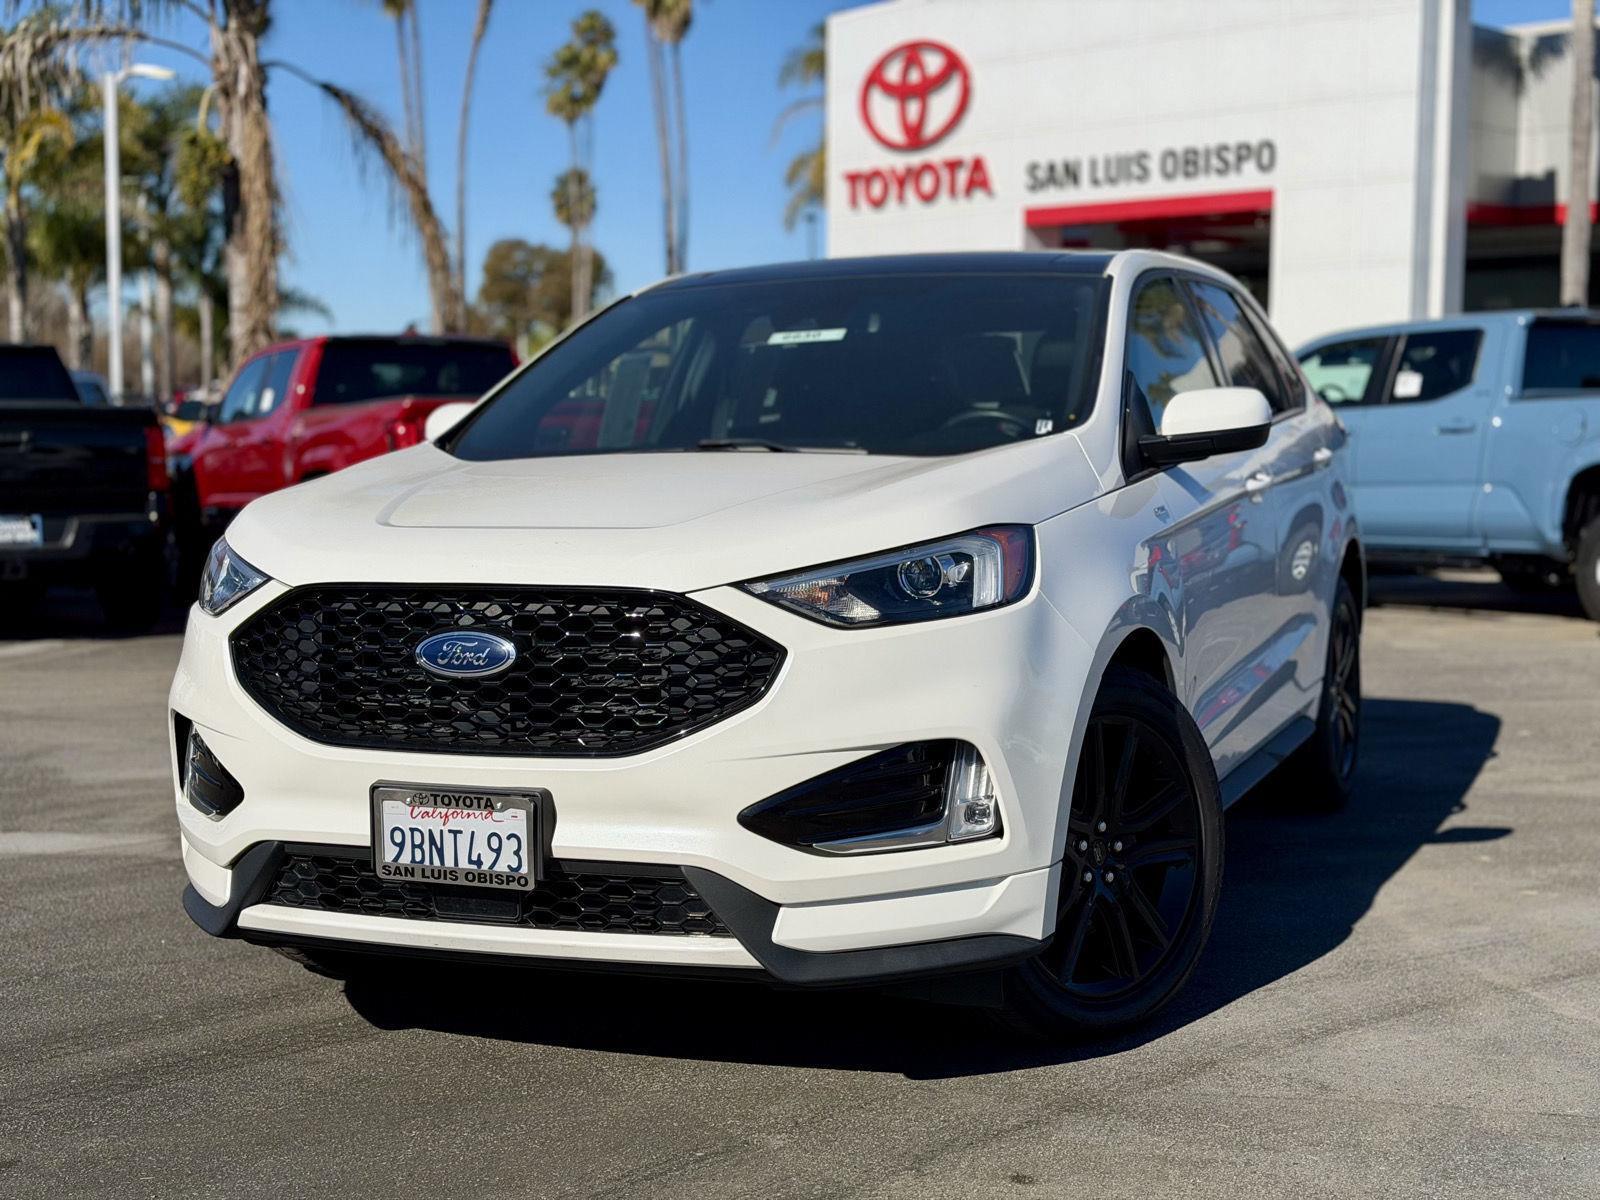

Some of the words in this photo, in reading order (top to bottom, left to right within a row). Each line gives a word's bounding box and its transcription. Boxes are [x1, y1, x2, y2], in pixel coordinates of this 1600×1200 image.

[1026, 159, 1080, 192] SAN
[1089, 152, 1150, 188] LUIS
[1160, 139, 1277, 179] OBISPO
[843, 156, 993, 209] TOYOTA
[437, 640, 491, 665] Ford
[430, 793, 495, 810] TOYOTA
[409, 805, 504, 826] California
[389, 826, 523, 873] 9BNT493
[381, 864, 415, 878] SAN
[421, 868, 459, 882] LUIS
[464, 871, 529, 887] OBISPO
